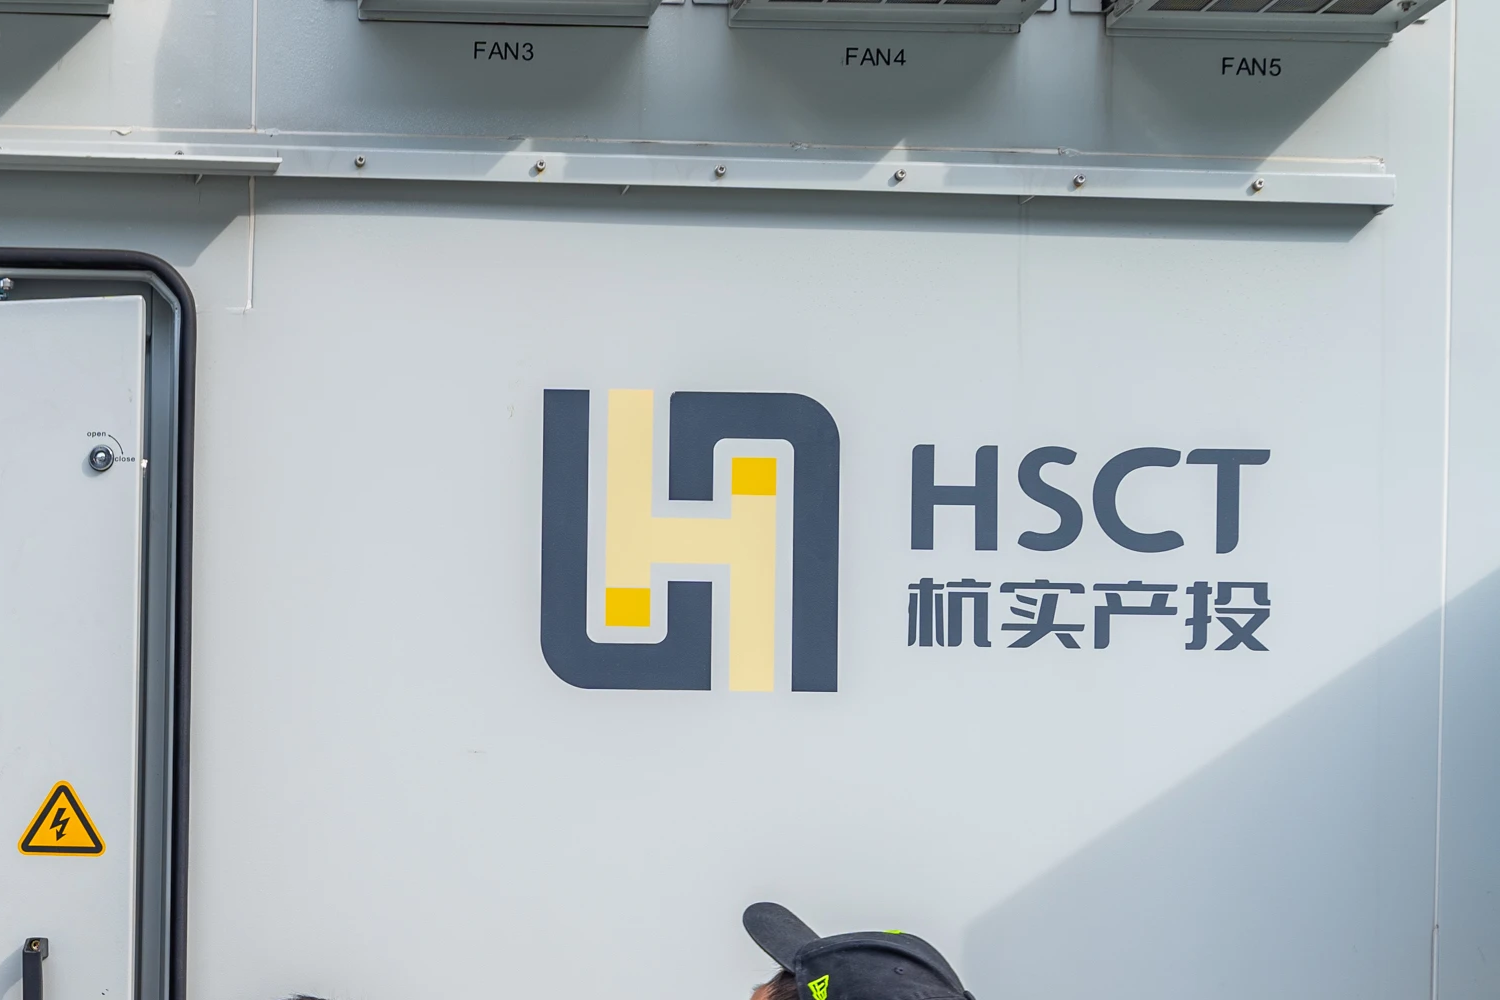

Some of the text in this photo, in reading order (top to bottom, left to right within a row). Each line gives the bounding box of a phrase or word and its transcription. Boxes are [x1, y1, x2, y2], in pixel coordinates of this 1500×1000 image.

[473, 41, 534, 61] FAN3
[845, 47, 907, 67] FAN4
[1221, 56, 1282, 77] FAN5
[910, 443, 1271, 555] HSCT
[907, 577, 1272, 652] 杭实产投
